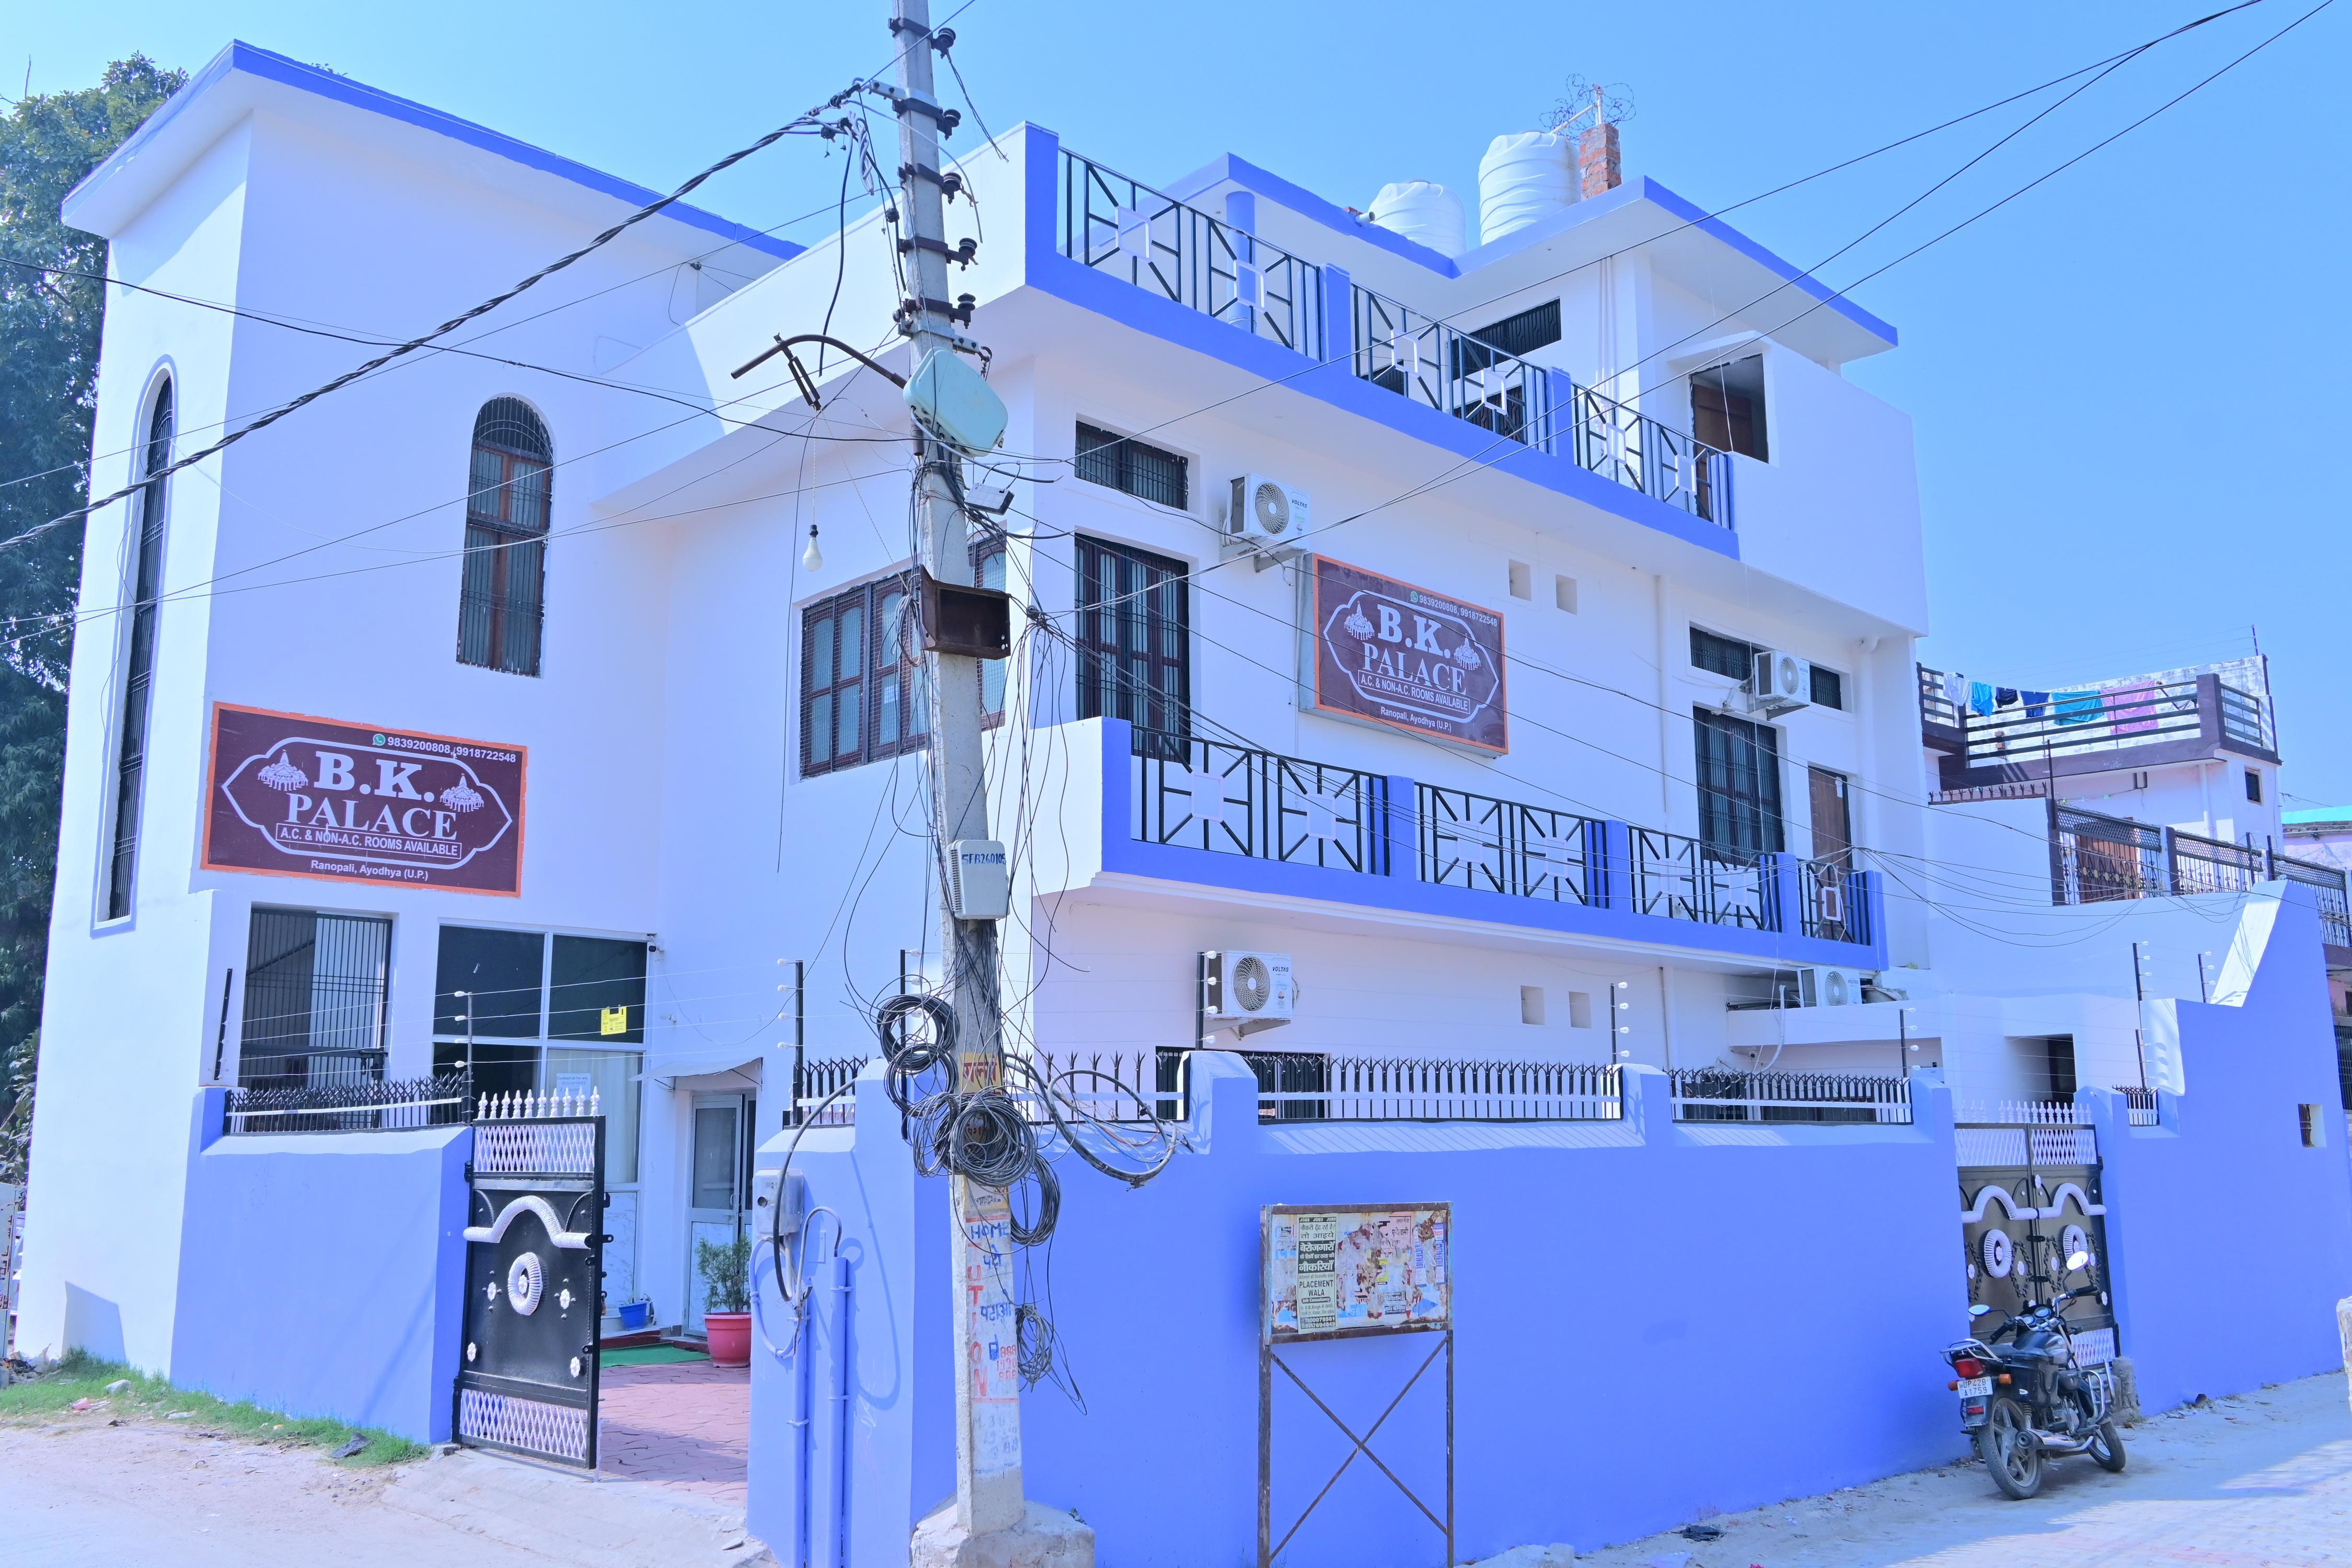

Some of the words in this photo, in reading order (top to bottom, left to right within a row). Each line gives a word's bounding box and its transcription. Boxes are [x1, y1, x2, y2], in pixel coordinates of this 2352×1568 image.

[1292, 499, 1308, 508] VOLTAS
[1419, 595, 1459, 616] 9839200808,
[1461, 607, 1497, 626] 9918722548
[1377, 604, 1451, 659] B.K.
[1362, 642, 1467, 695] PALACE
[1361, 674, 1374, 687] A.C.
[1376, 678, 1380, 688] &
[1382, 680, 1410, 696] NON-A.C.
[1411, 687, 1434, 702] ROOMS
[1435, 693, 1468, 710] AVAILABLE
[1381, 706, 1409, 721] Ranopali,
[1410, 713, 1435, 727] Ayodhya
[1437, 720, 1452, 733] (U.P.)
[387, 736, 453, 755] 9839200808,
[456, 746, 516, 763] 9918722548
[314, 751, 435, 802] B.K.
[285, 792, 457, 840] PALACE
[281, 827, 302, 840] A.C.
[305, 829, 312, 840] &
[315, 830, 362, 847] NON-A.C.
[365, 836, 402, 851] ROOMS
[404, 840, 458, 857] AVAILABLE
[312, 860, 357, 874] Ranopali,
[360, 864, 401, 878] Ayodhya
[404, 869, 428, 881] (U.P.)
[971, 1222, 1010, 1239] HOME
[1313, 1231, 1334, 1239] आइये
[1299, 1279, 1333, 1288] PLACEMENT
[1965, 1387, 1987, 1397] A1759
